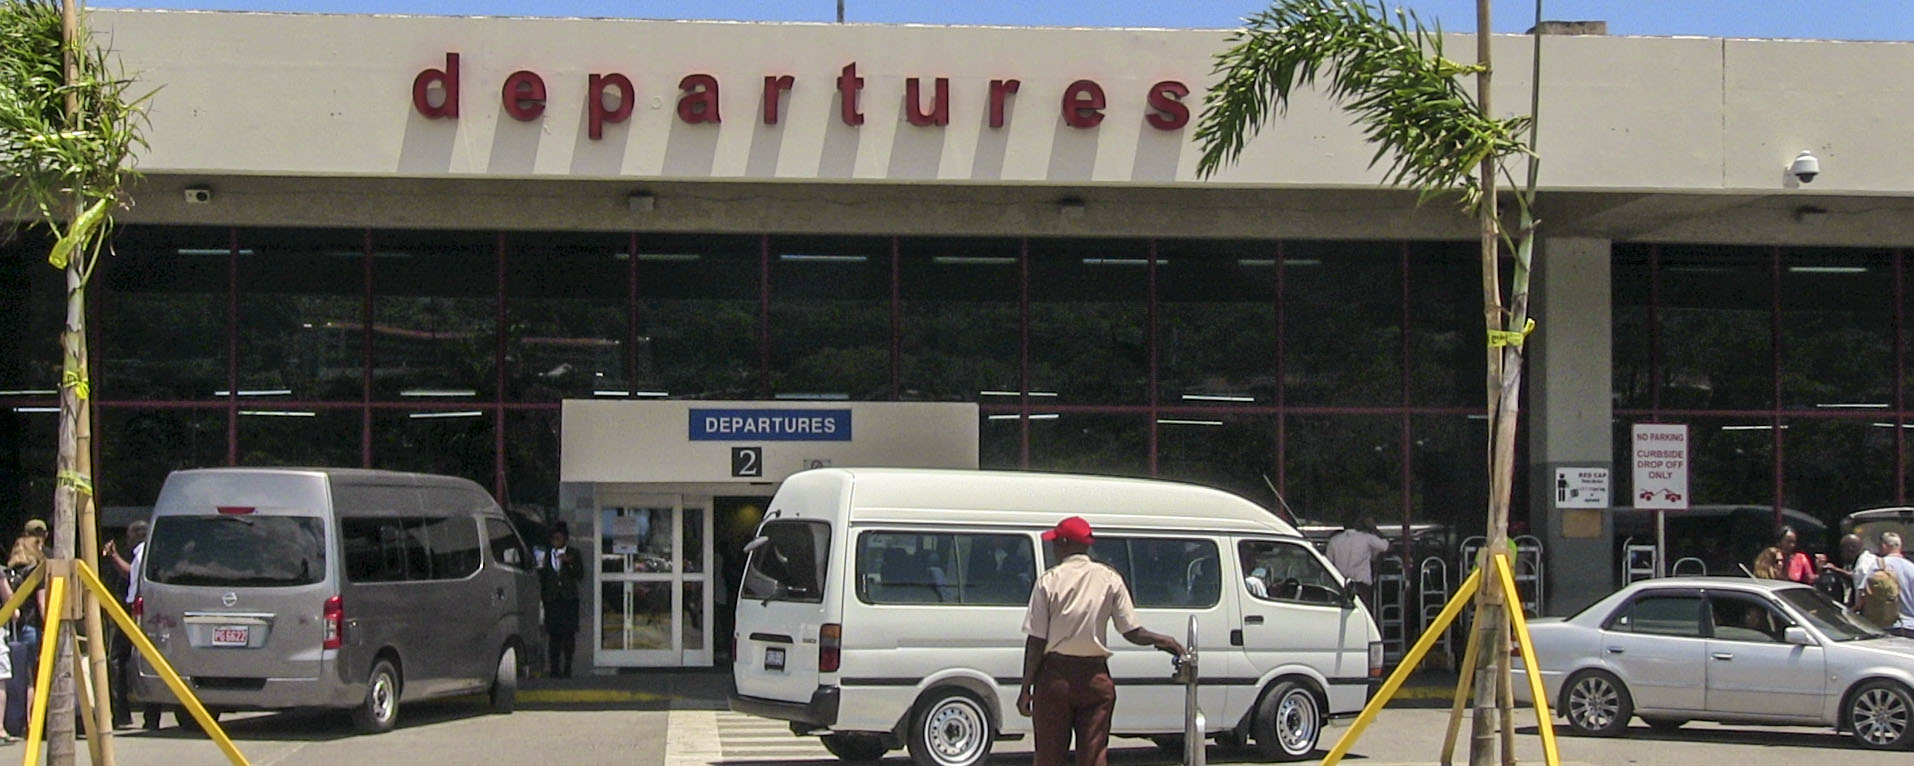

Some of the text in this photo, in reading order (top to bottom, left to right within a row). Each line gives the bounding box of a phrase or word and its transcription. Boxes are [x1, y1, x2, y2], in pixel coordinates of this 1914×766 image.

[411, 52, 1191, 140] departures
[705, 417, 836, 433] DEPARTURES
[1637, 433, 1684, 442] NO PARKING
[1637, 450, 1684, 459] CURBSIDE
[739, 450, 757, 475] 2
[1637, 460, 1683, 468] DROP OFF
[1648, 471, 1673, 479] ONLY
